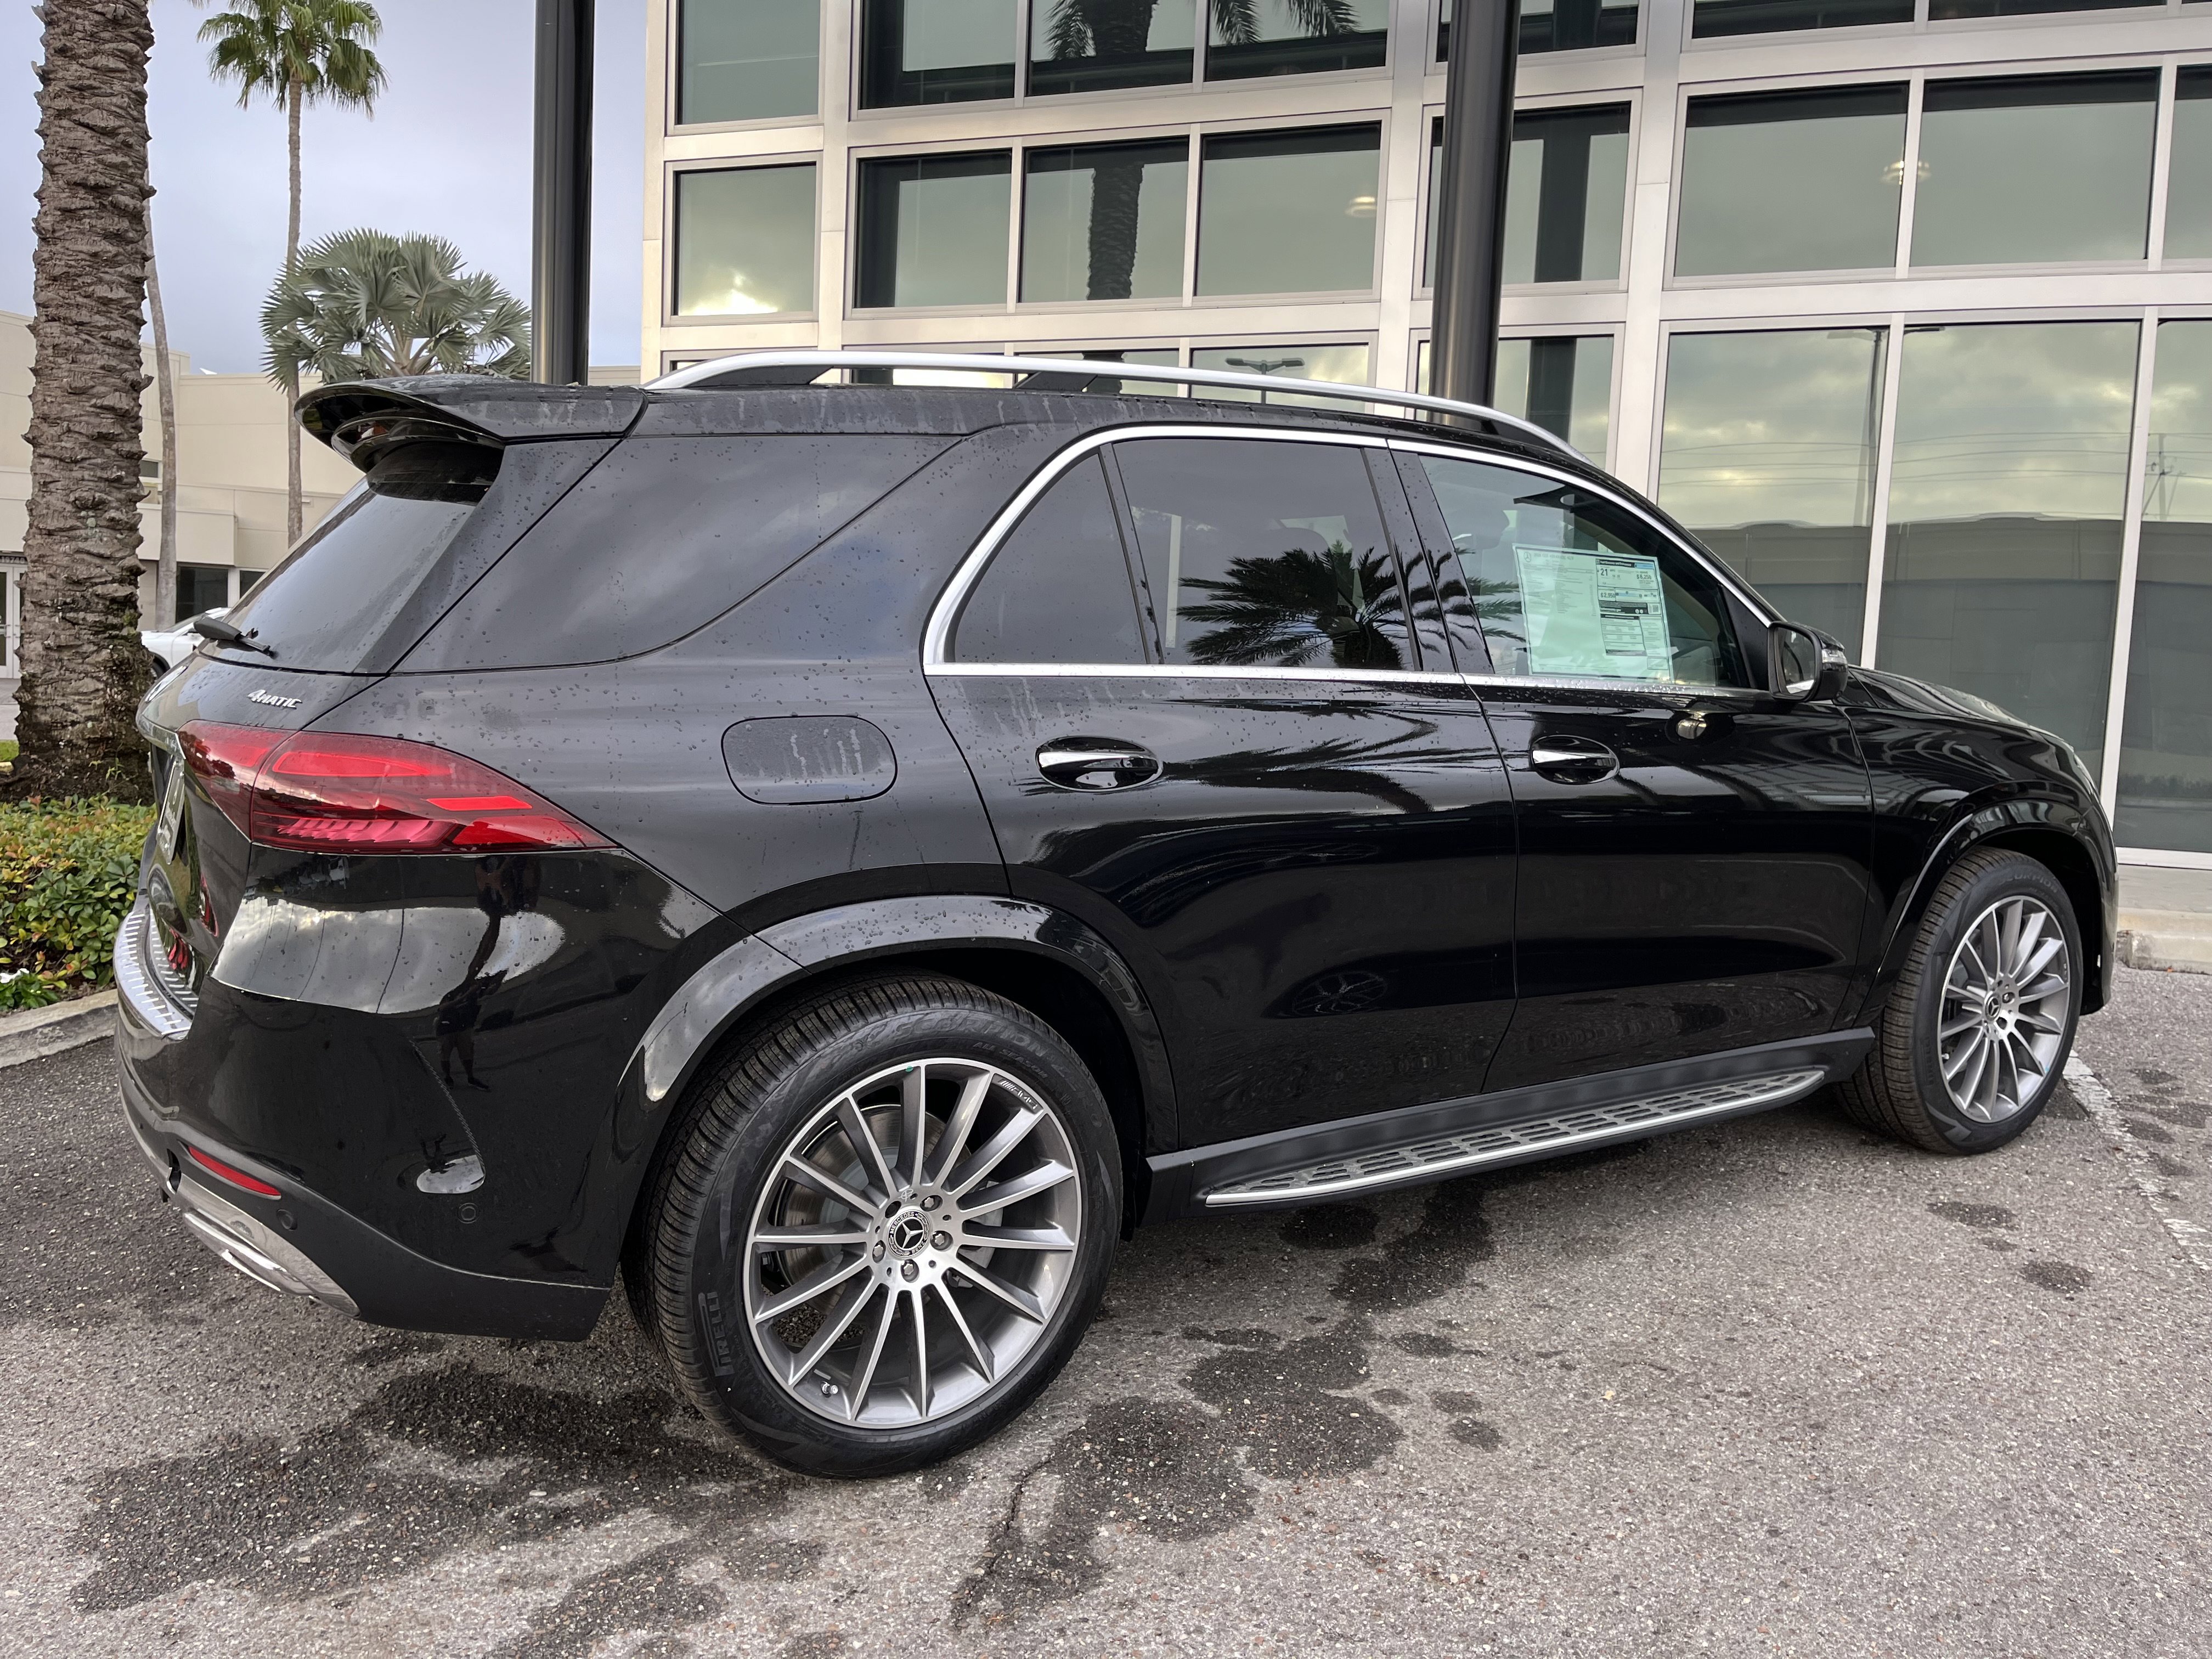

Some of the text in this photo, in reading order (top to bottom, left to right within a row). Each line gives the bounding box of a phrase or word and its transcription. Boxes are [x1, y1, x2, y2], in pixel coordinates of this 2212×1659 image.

[247, 689, 302, 708] 4MATIC
[893, 1013, 1049, 1057] SCORPION
[973, 1042, 1048, 1079] ALL SEASON
[889, 1211, 915, 1234] MERCEDES
[911, 1240, 926, 1255] BENZ
[698, 1291, 735, 1376] PIRELLI
